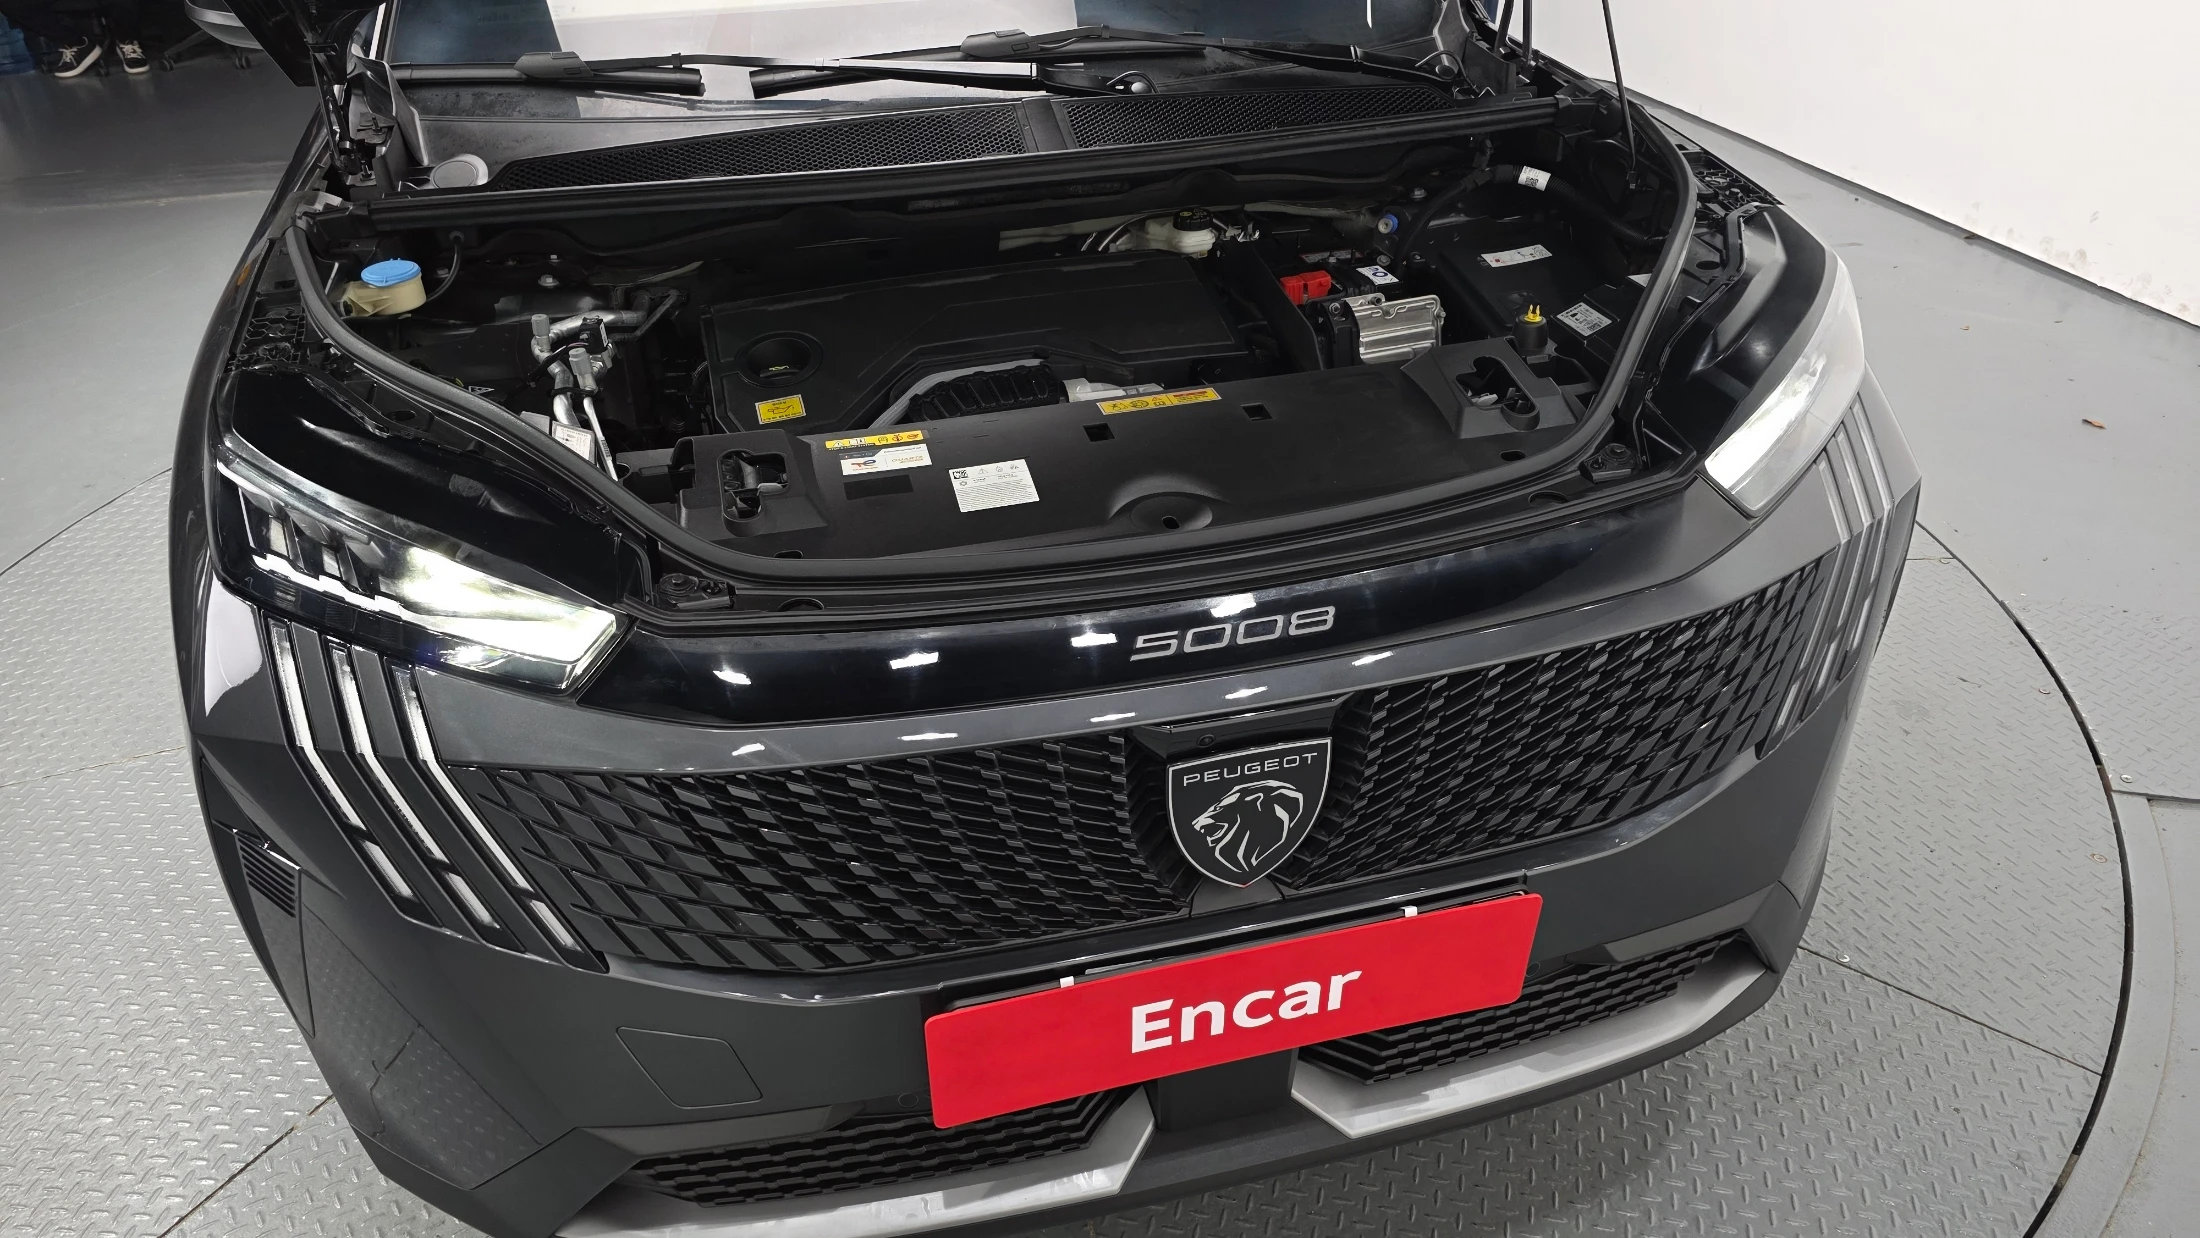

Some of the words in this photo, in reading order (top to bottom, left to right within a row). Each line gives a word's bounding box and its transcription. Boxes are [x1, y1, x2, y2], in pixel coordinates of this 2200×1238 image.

[1130, 605, 1336, 662] 5008
[1183, 752, 1318, 787] PEUGEOT
[1131, 970, 1362, 1054] Encar
